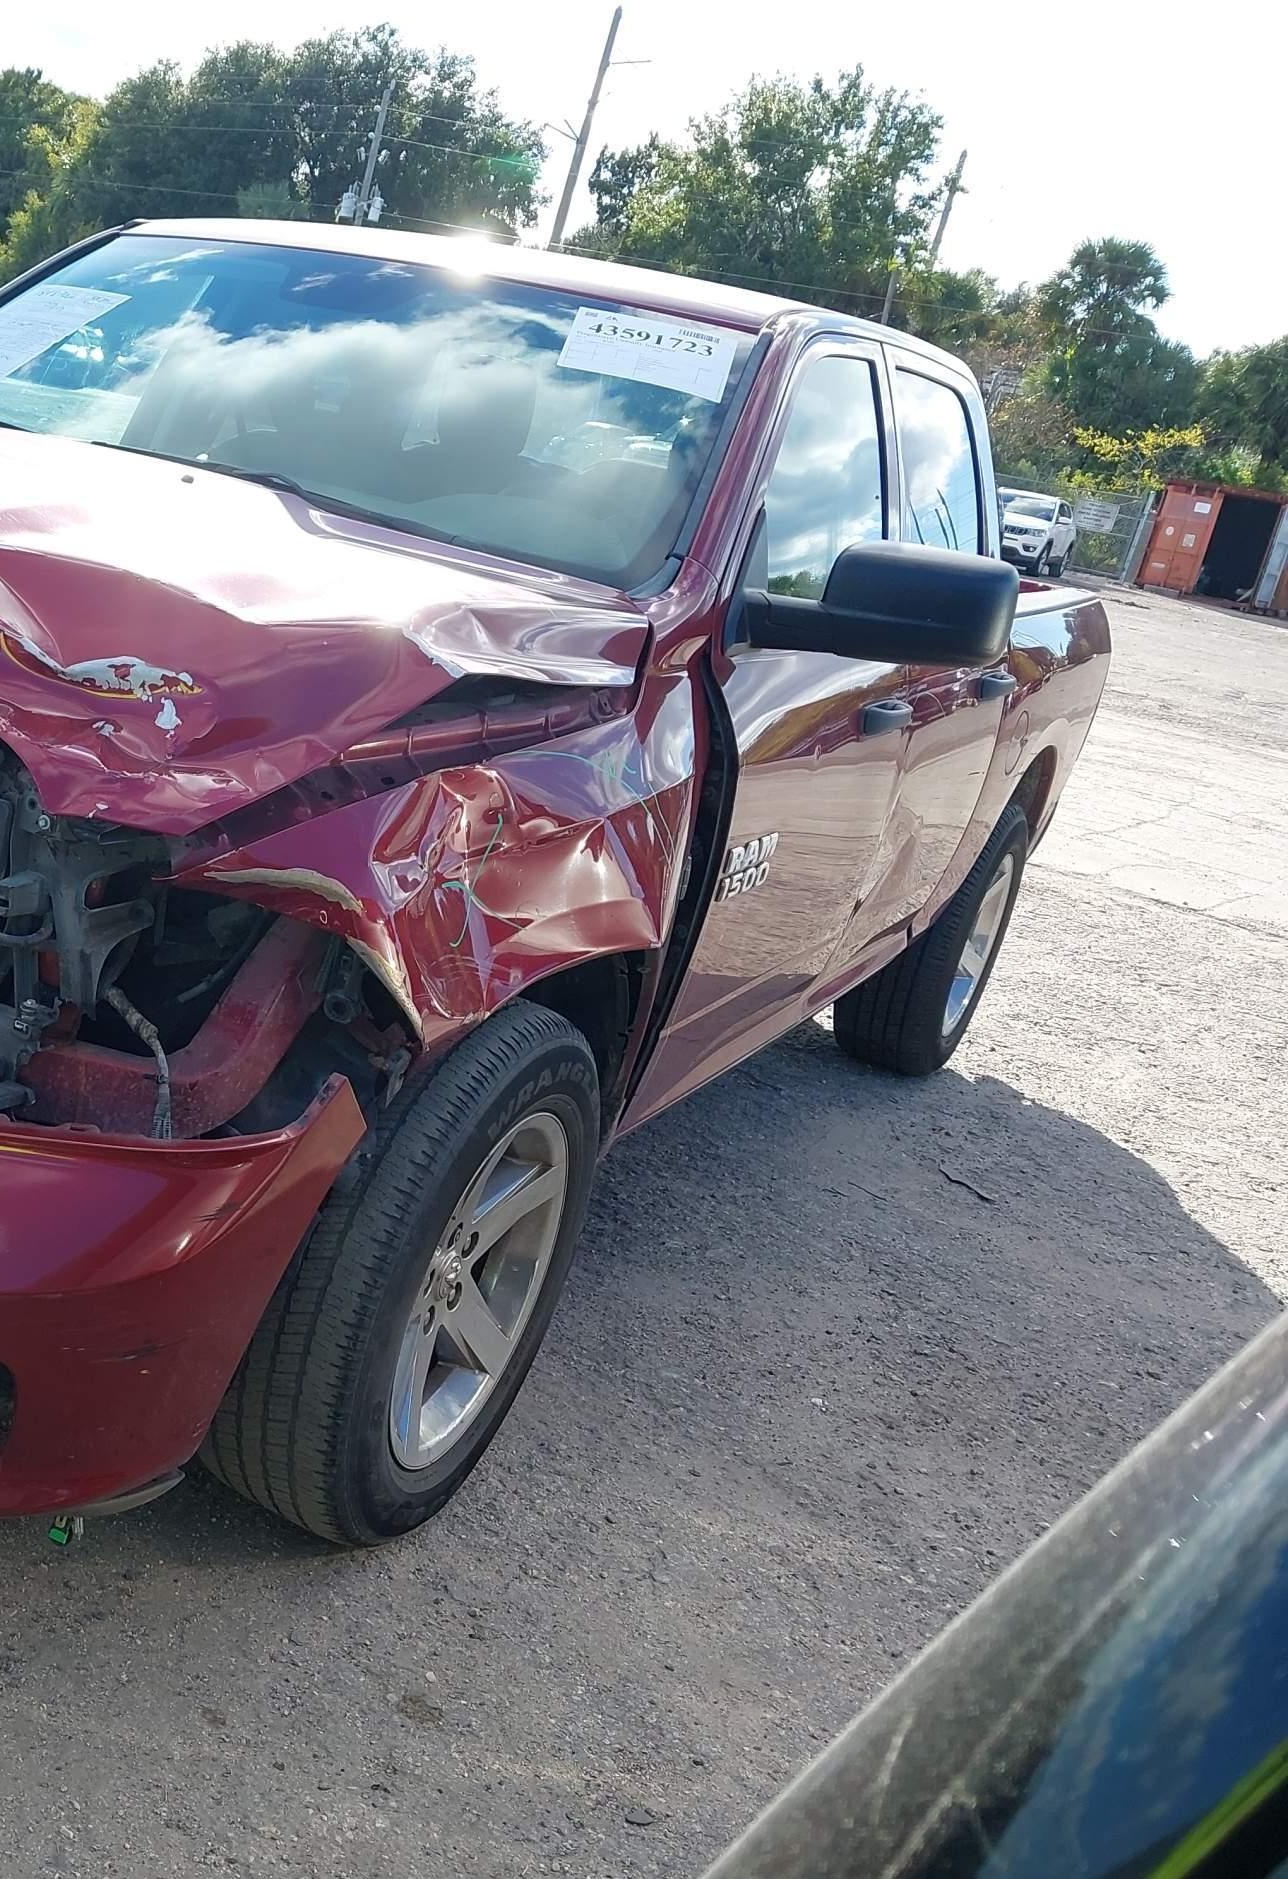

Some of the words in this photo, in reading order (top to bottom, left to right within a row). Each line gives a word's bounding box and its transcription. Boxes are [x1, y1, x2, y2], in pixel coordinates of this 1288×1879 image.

[588, 322, 713, 357] 43591723
[725, 831, 779, 875] RAM
[716, 861, 769, 902] 1500
